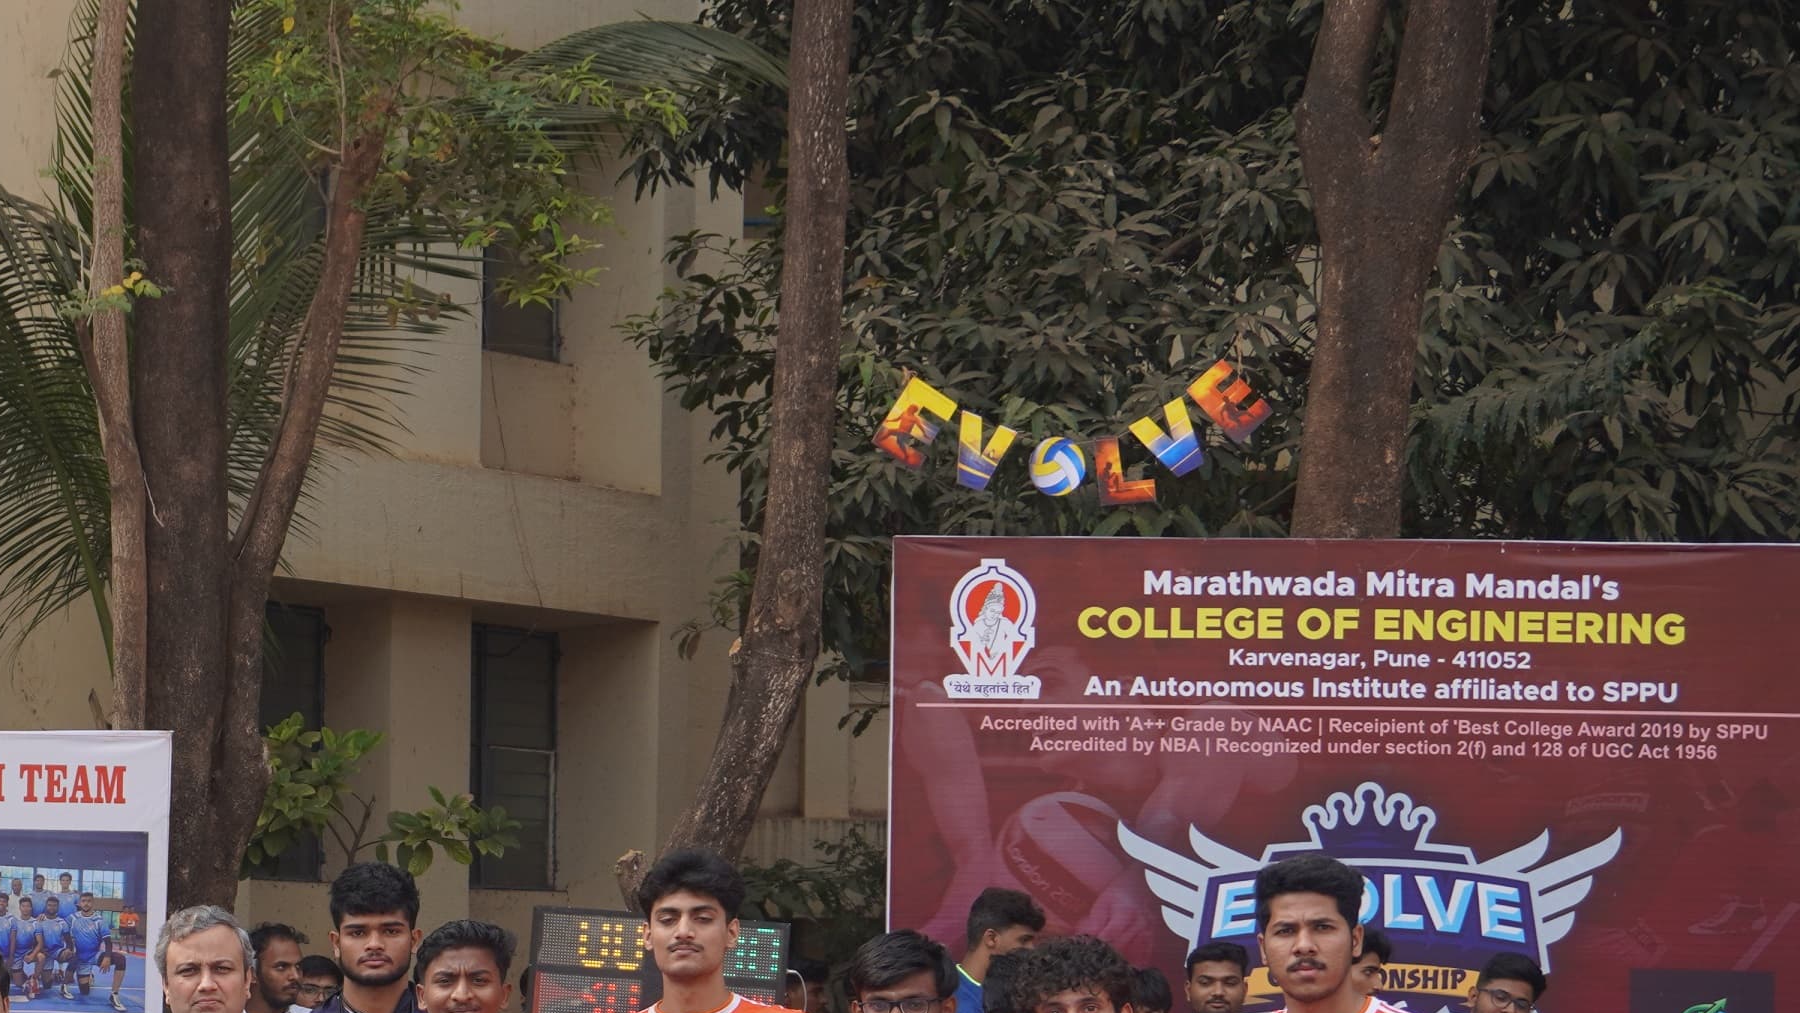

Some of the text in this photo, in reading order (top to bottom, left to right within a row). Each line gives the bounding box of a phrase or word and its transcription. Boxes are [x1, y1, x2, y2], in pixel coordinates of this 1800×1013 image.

[1144, 570, 1619, 601] Marathwada Mitra Mandal's
[1077, 606, 1686, 645] COLLEGE OF ENGINEERING
[1228, 649, 1367, 672] Karvenagar,
[1373, 650, 1431, 669] Pune
[1452, 651, 1531, 670] 411052
[1084, 676, 1679, 703] An Autonomous Institute affiliated to SPPU
[980, 715, 1076, 731] Accredited
[1082, 716, 1119, 731] with
[1171, 716, 1225, 732] Grade
[1230, 717, 1253, 736] by
[1258, 718, 1312, 733] NAAC
[1328, 718, 1427, 739] Receipient
[1430, 719, 1449, 735] of
[1453, 719, 1499, 736] 'Best
[1504, 720, 1573, 740] College
[1577, 721, 1637, 738] Award
[1640, 723, 1684, 738] 2019
[1689, 723, 1711, 742] by
[1716, 723, 1768, 740] SPPU
[1029, 736, 1128, 752] Accredited
[1132, 737, 1154, 755] by
[1160, 738, 1200, 752] NBA
[1216, 738, 1322, 756] Recognized
[1327, 739, 1380, 755] under
[1385, 740, 1452, 756] section
[1456, 741, 1487, 759] 2(f)
[1492, 741, 1526, 757] and
[1532, 742, 1563, 758] 128
[1567, 742, 1587, 758] of
[1591, 743, 1634, 760] UGC
[1638, 744, 1669, 760] Act
[1675, 744, 1718, 760] 1956
[20, 764, 127, 804] TEAM
